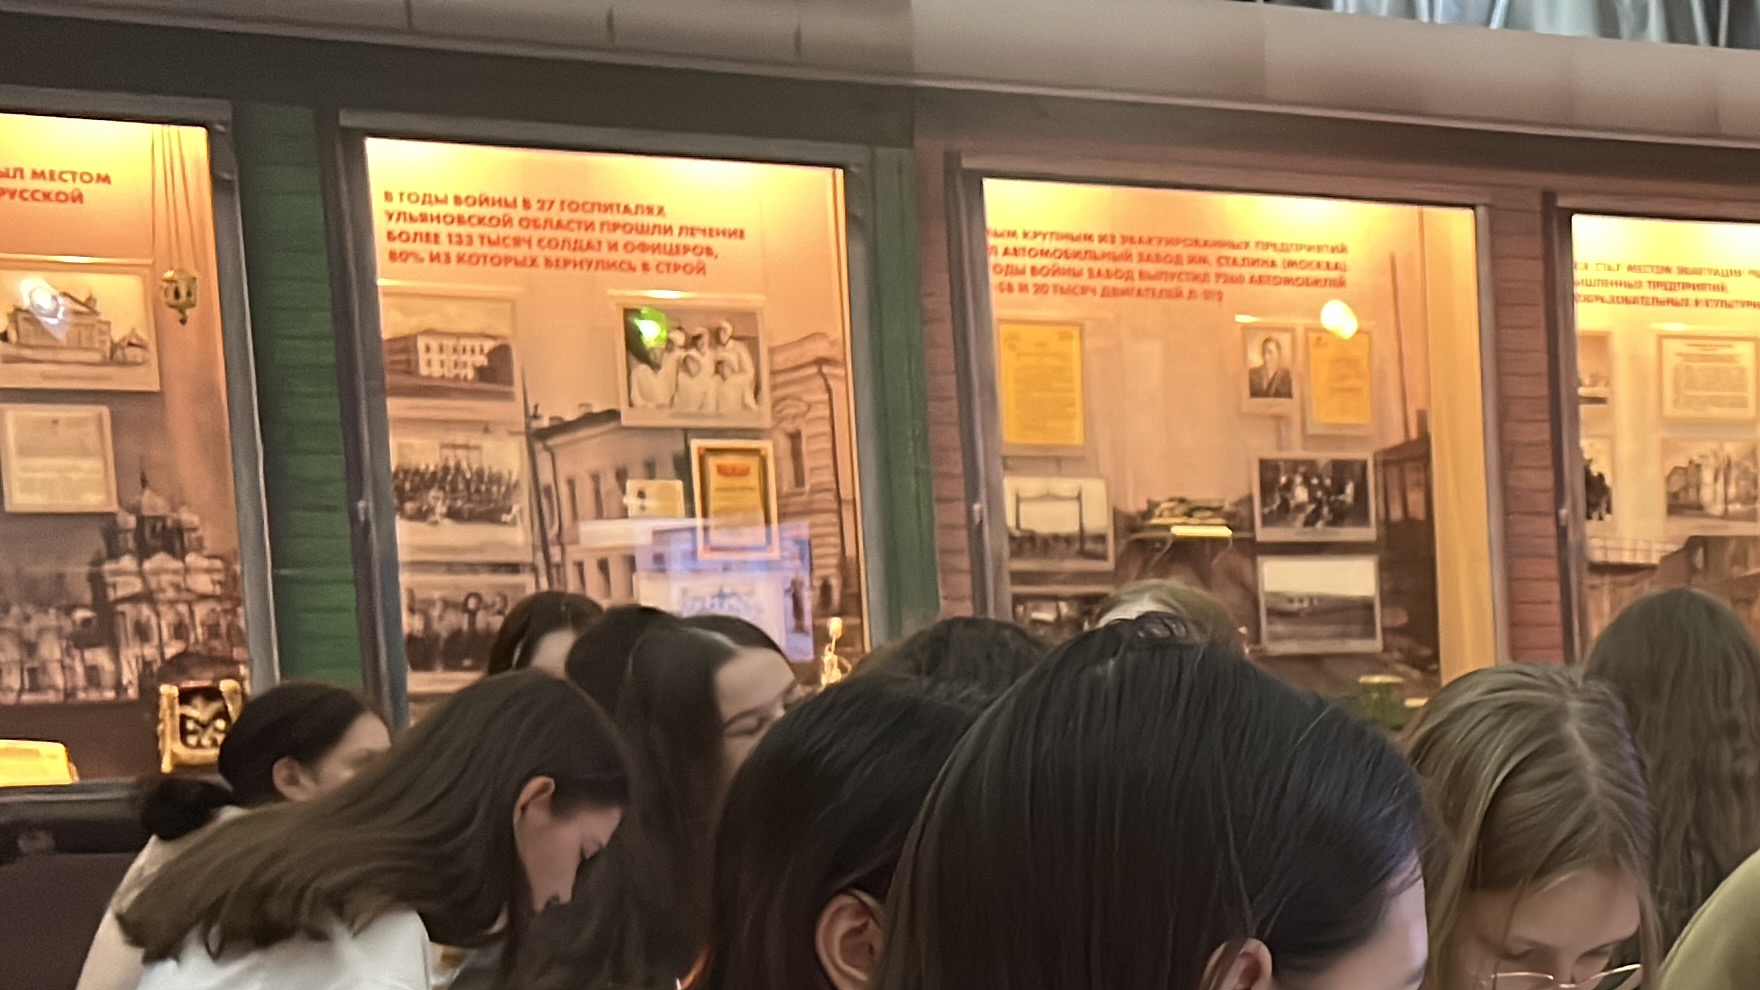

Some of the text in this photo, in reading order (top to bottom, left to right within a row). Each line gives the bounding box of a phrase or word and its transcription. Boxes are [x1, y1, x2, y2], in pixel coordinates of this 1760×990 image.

[30, 168, 112, 185] МЕСТОМ
[398, 191, 449, 207] ГОДЫ
[453, 193, 518, 210] ВОЙНЫ
[559, 199, 667, 218] ГОСПИТАЛЯХ
[385, 209, 746, 241] УЛЬЯНОВСКОЙ ОБЛАСТИ ПРОШЛИ ЛЕЧЕНИЕ
[386, 230, 441, 246] БОЛЕЕ
[478, 233, 533, 250] ТЫСЯЧ
[536, 236, 603, 253] СОЛДАТ
[607, 240, 619, 252] И
[622, 240, 719, 260] ОФИЦЕРОВ,
[428, 250, 452, 265] ИЗ
[455, 251, 540, 269] КОТОРЫХ
[543, 256, 637, 274] ВЕРНУЛИСЬ
[655, 260, 707, 276] СТРОЙ
[1029, 262, 1085, 278] ВОЙНЫ
